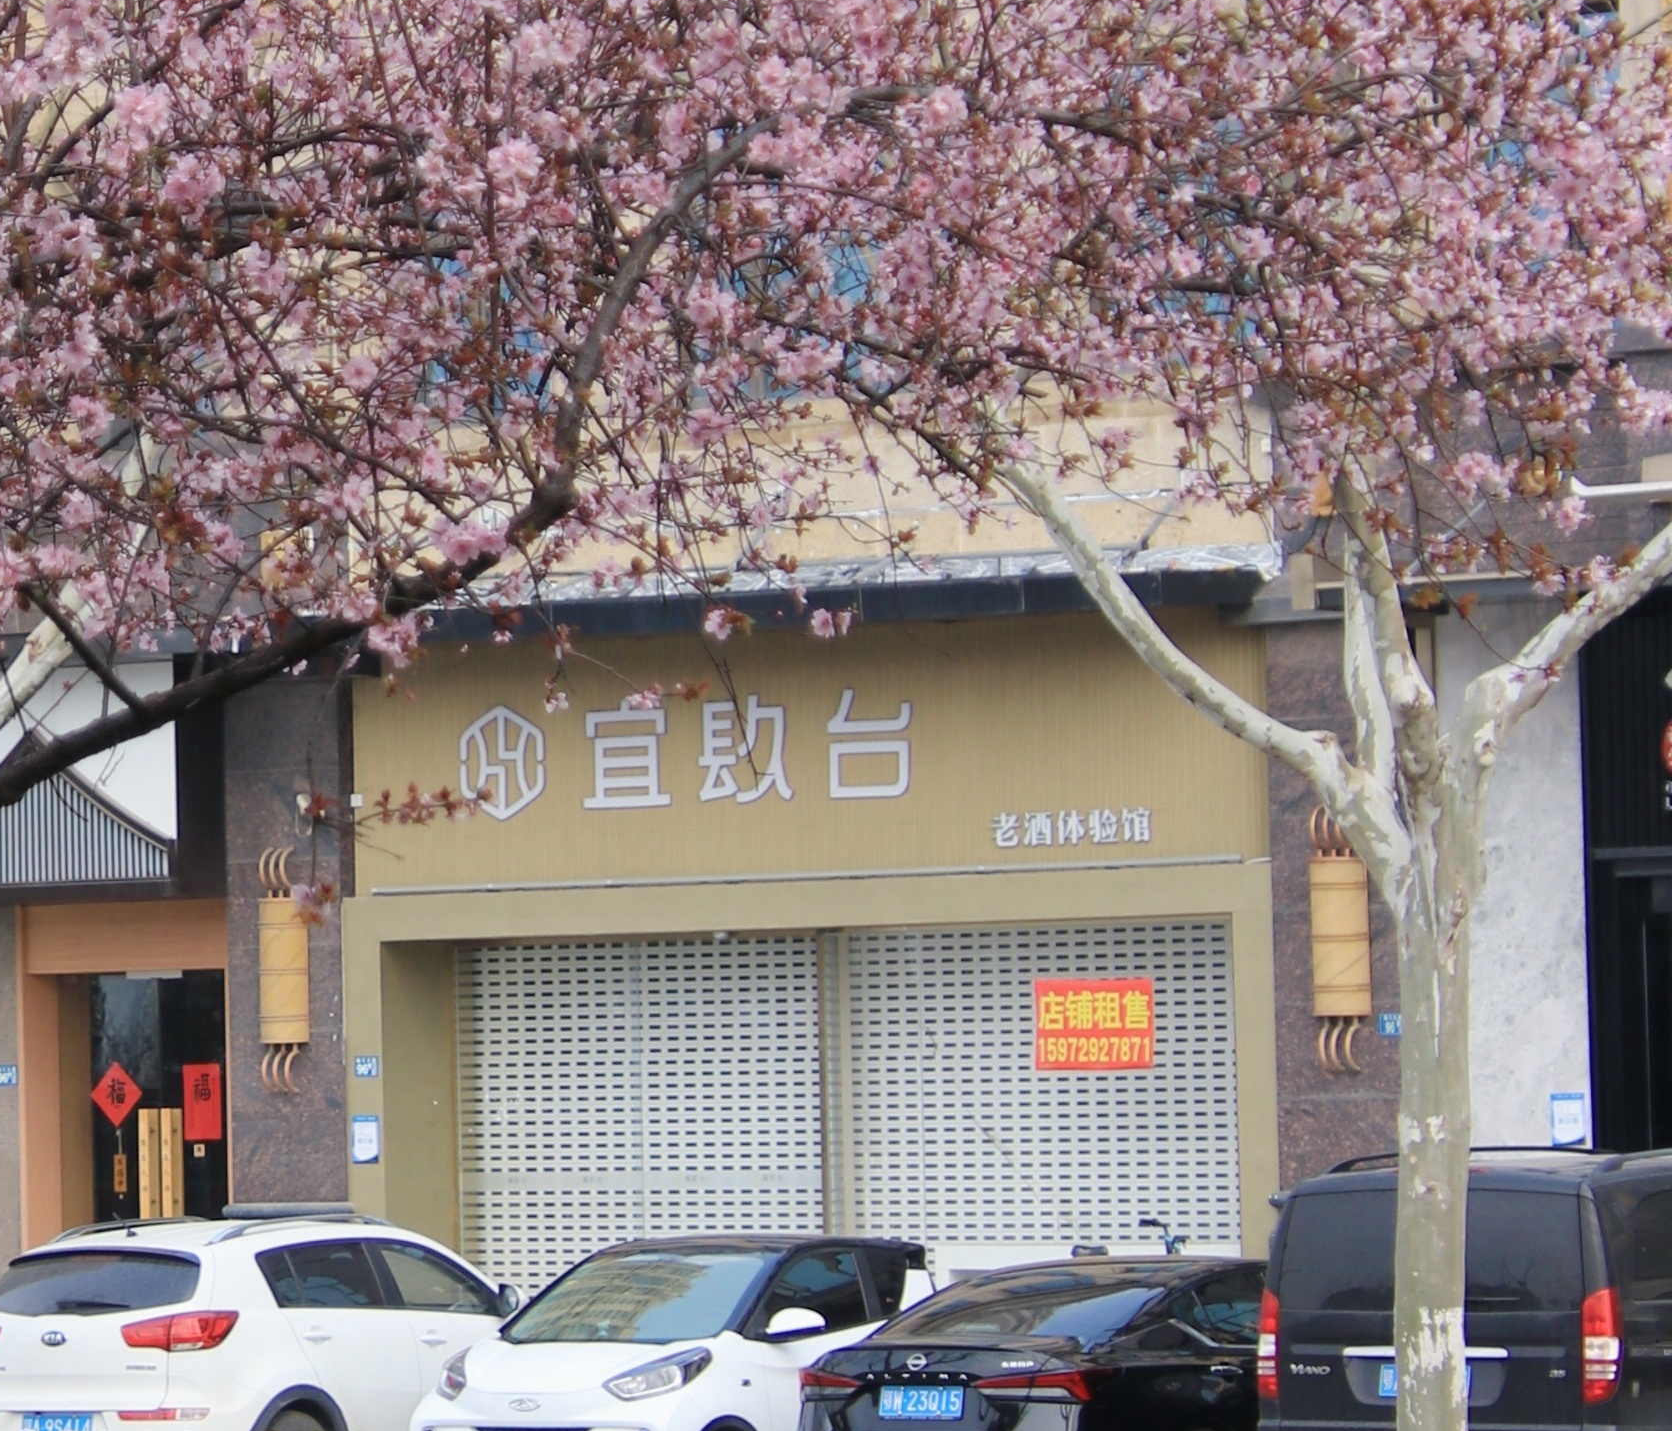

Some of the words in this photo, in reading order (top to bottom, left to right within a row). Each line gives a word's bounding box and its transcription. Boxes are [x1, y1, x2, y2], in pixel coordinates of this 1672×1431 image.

[991, 807, 1152, 848] 老酒体验馆
[1038, 990, 1151, 1030] 店铺租售
[1038, 1036, 1150, 1063] 15972927871
[107, 1078, 126, 1105] 福
[194, 1073, 212, 1103] 福
